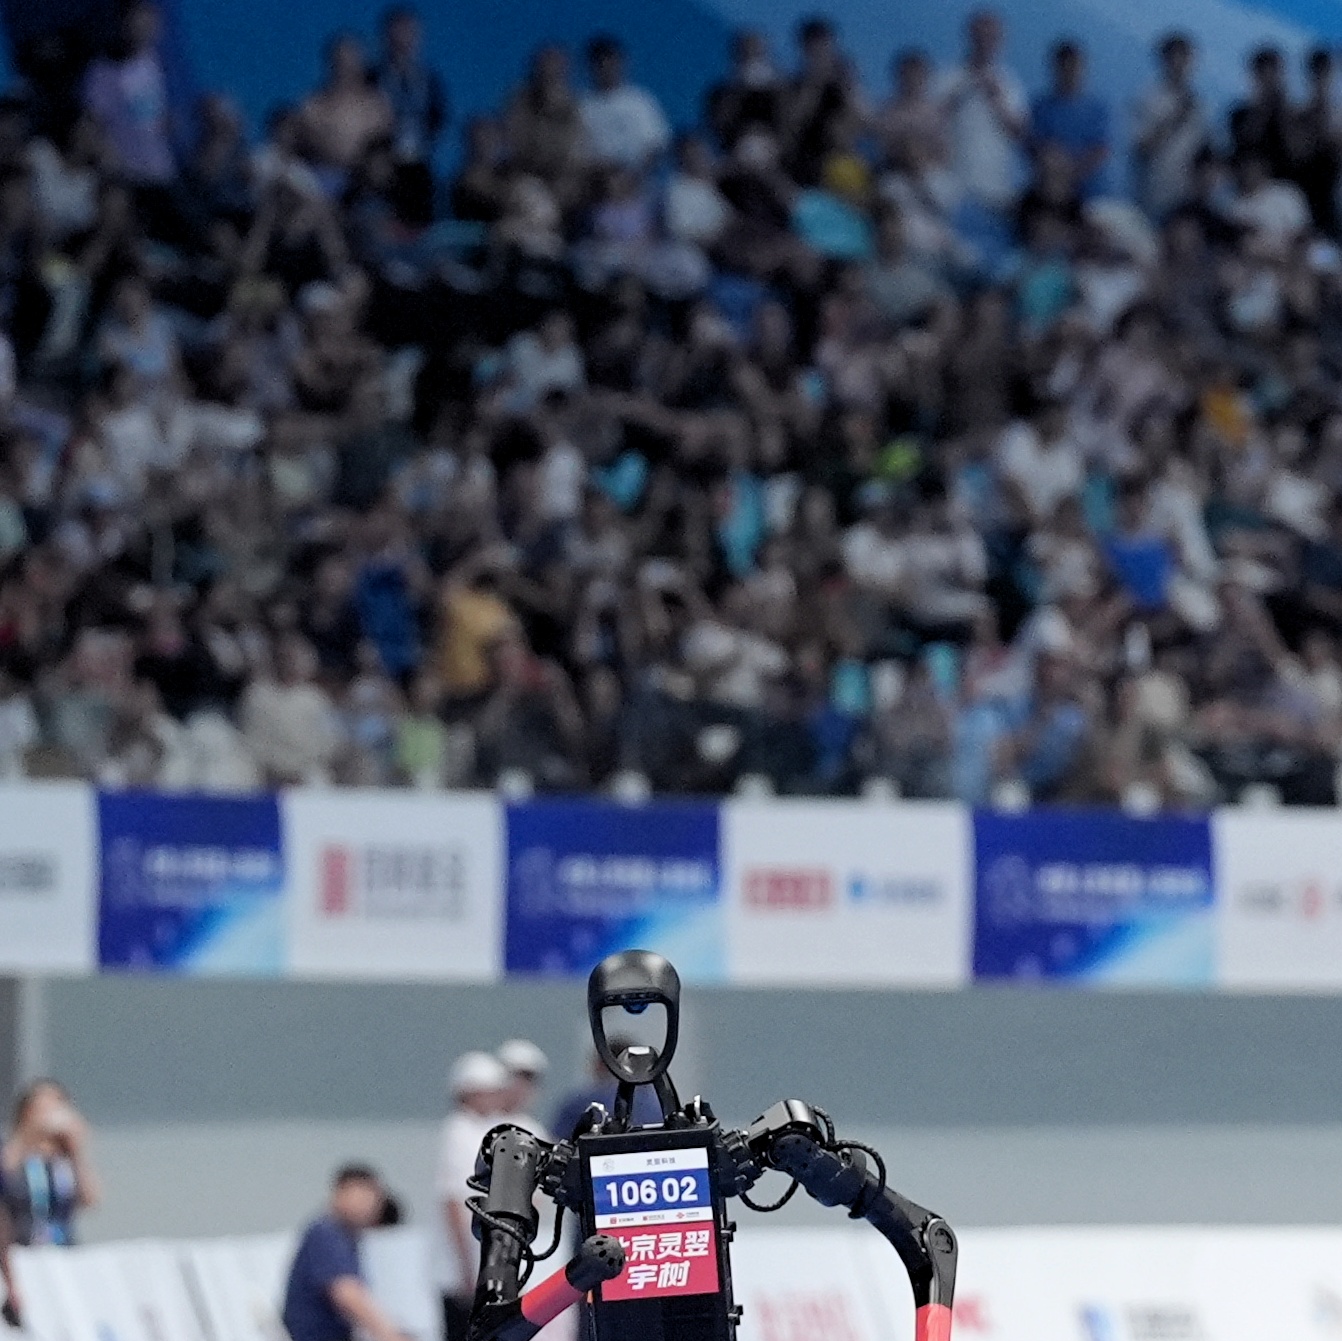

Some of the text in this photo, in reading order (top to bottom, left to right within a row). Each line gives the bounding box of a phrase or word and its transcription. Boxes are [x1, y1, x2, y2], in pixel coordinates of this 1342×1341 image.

[606, 1176, 698, 1207] 106 02
[627, 1260, 690, 1290] 宇树
